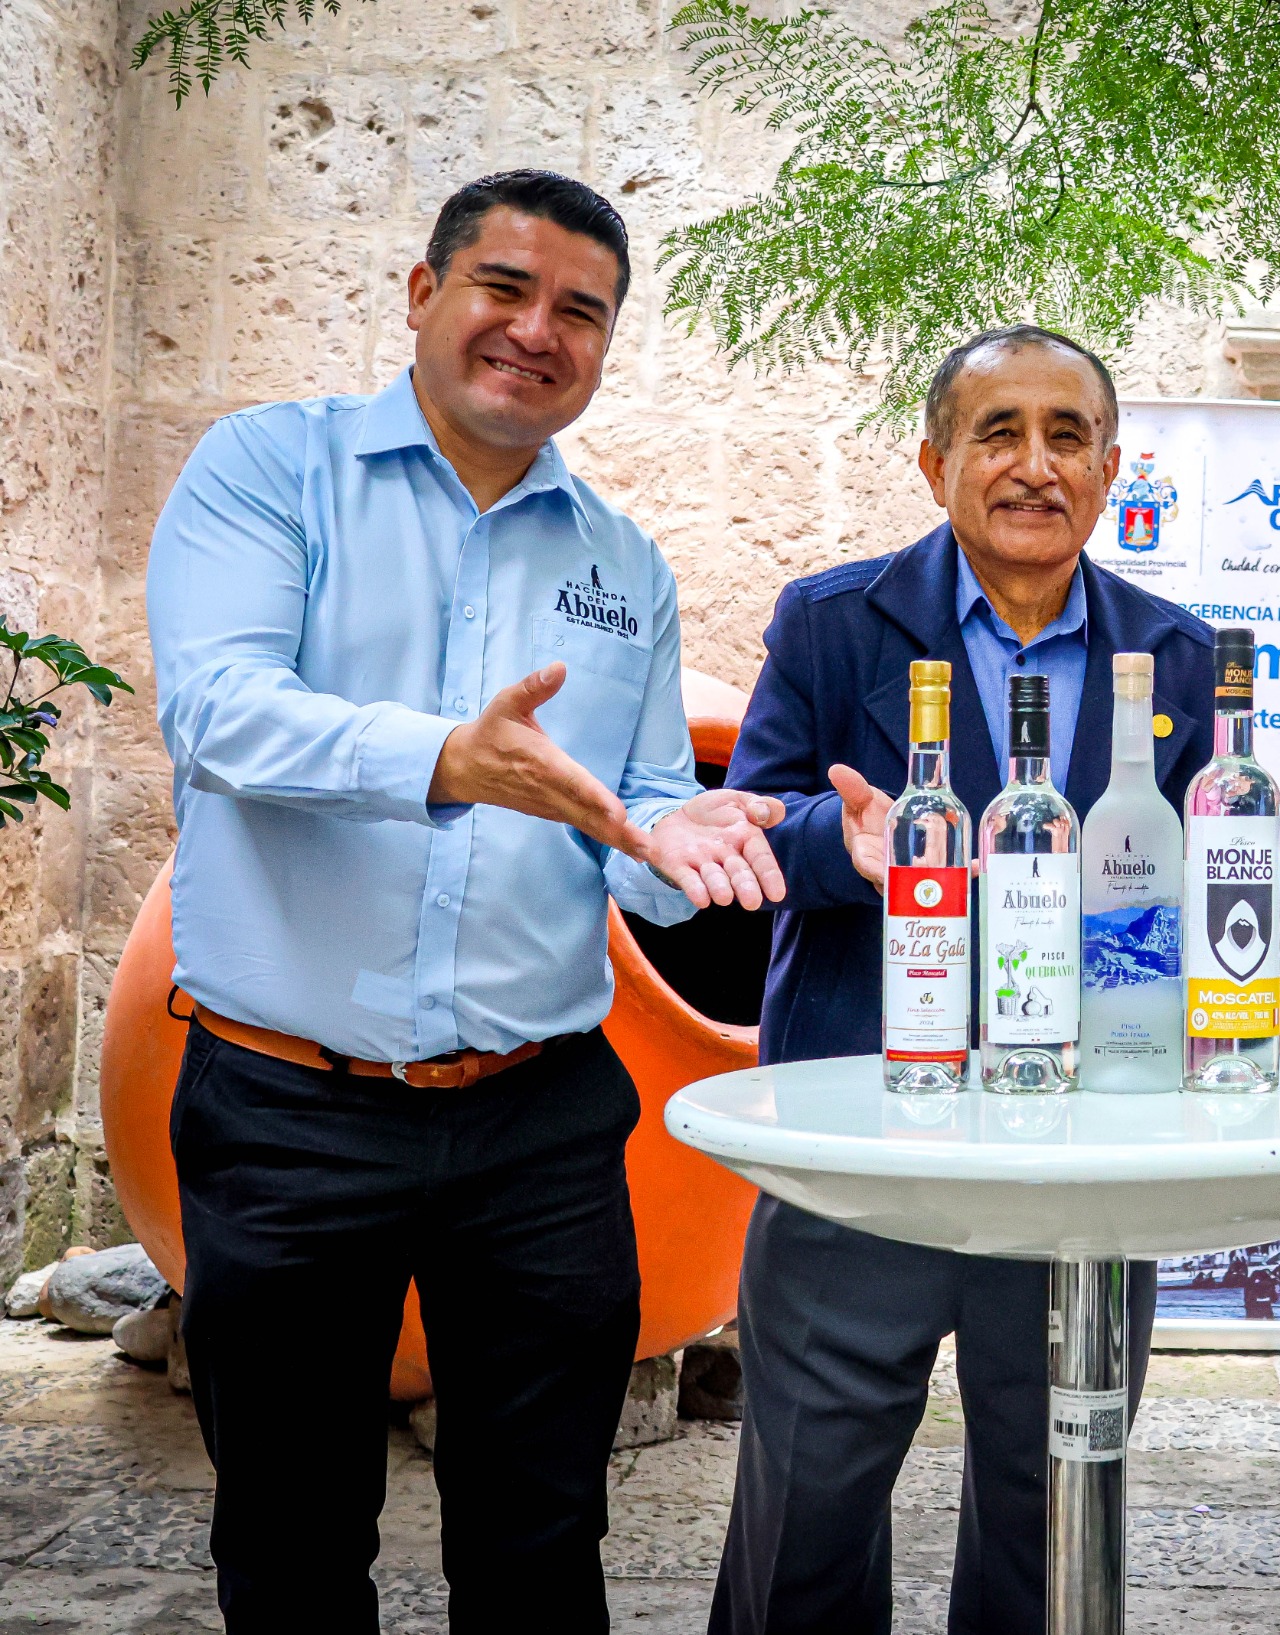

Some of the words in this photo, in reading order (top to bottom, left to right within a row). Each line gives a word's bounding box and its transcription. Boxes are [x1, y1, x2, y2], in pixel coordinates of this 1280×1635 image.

[1126, 567, 1164, 576] Arequipa
[1148, 560, 1188, 569] Provincial
[1221, 557, 1262, 572] Ciudad
[566, 580, 627, 603] HACIENDA
[587, 595, 608, 606] DEL
[553, 588, 639, 637] Abuelo
[1178, 603, 1274, 621] GERENCIA
[1229, 836, 1256, 846] Pisco
[1206, 848, 1272, 865] MONJE
[1101, 859, 1156, 876] Abuelo
[1206, 865, 1273, 881] BLANCO
[1001, 889, 1068, 910] Abuelo
[905, 919, 947, 938] Torre
[889, 938, 906, 957] De
[908, 940, 932, 957] La
[1041, 951, 1065, 961] PISCO
[1025, 964, 1075, 980] QUEBRANTA
[1199, 990, 1277, 1006] MOSCATEL
